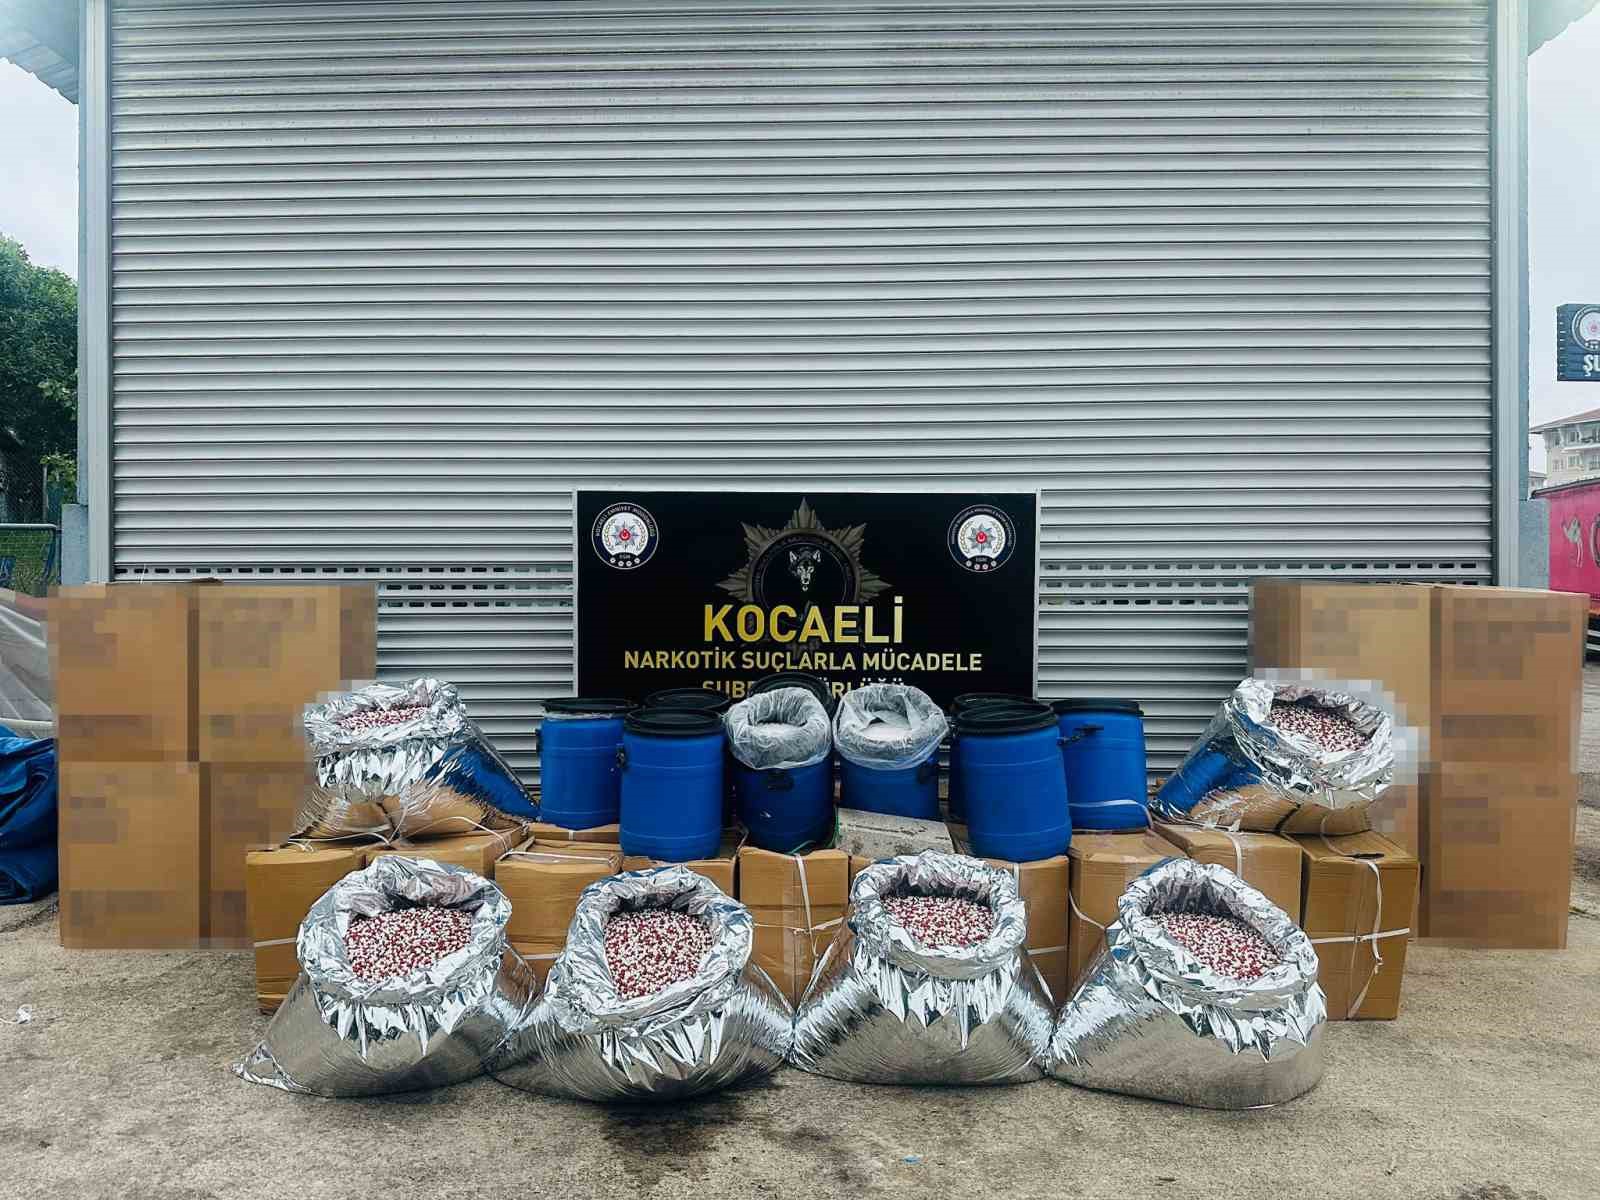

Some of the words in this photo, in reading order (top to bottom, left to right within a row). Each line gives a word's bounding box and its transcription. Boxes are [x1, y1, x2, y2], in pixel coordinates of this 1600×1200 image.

[703, 596, 904, 644] KOCAELİ
[624, 646, 737, 670] NARKOTİK
[741, 650, 856, 673] SUÇLARLA
[862, 647, 983, 671] MÜCADELE
